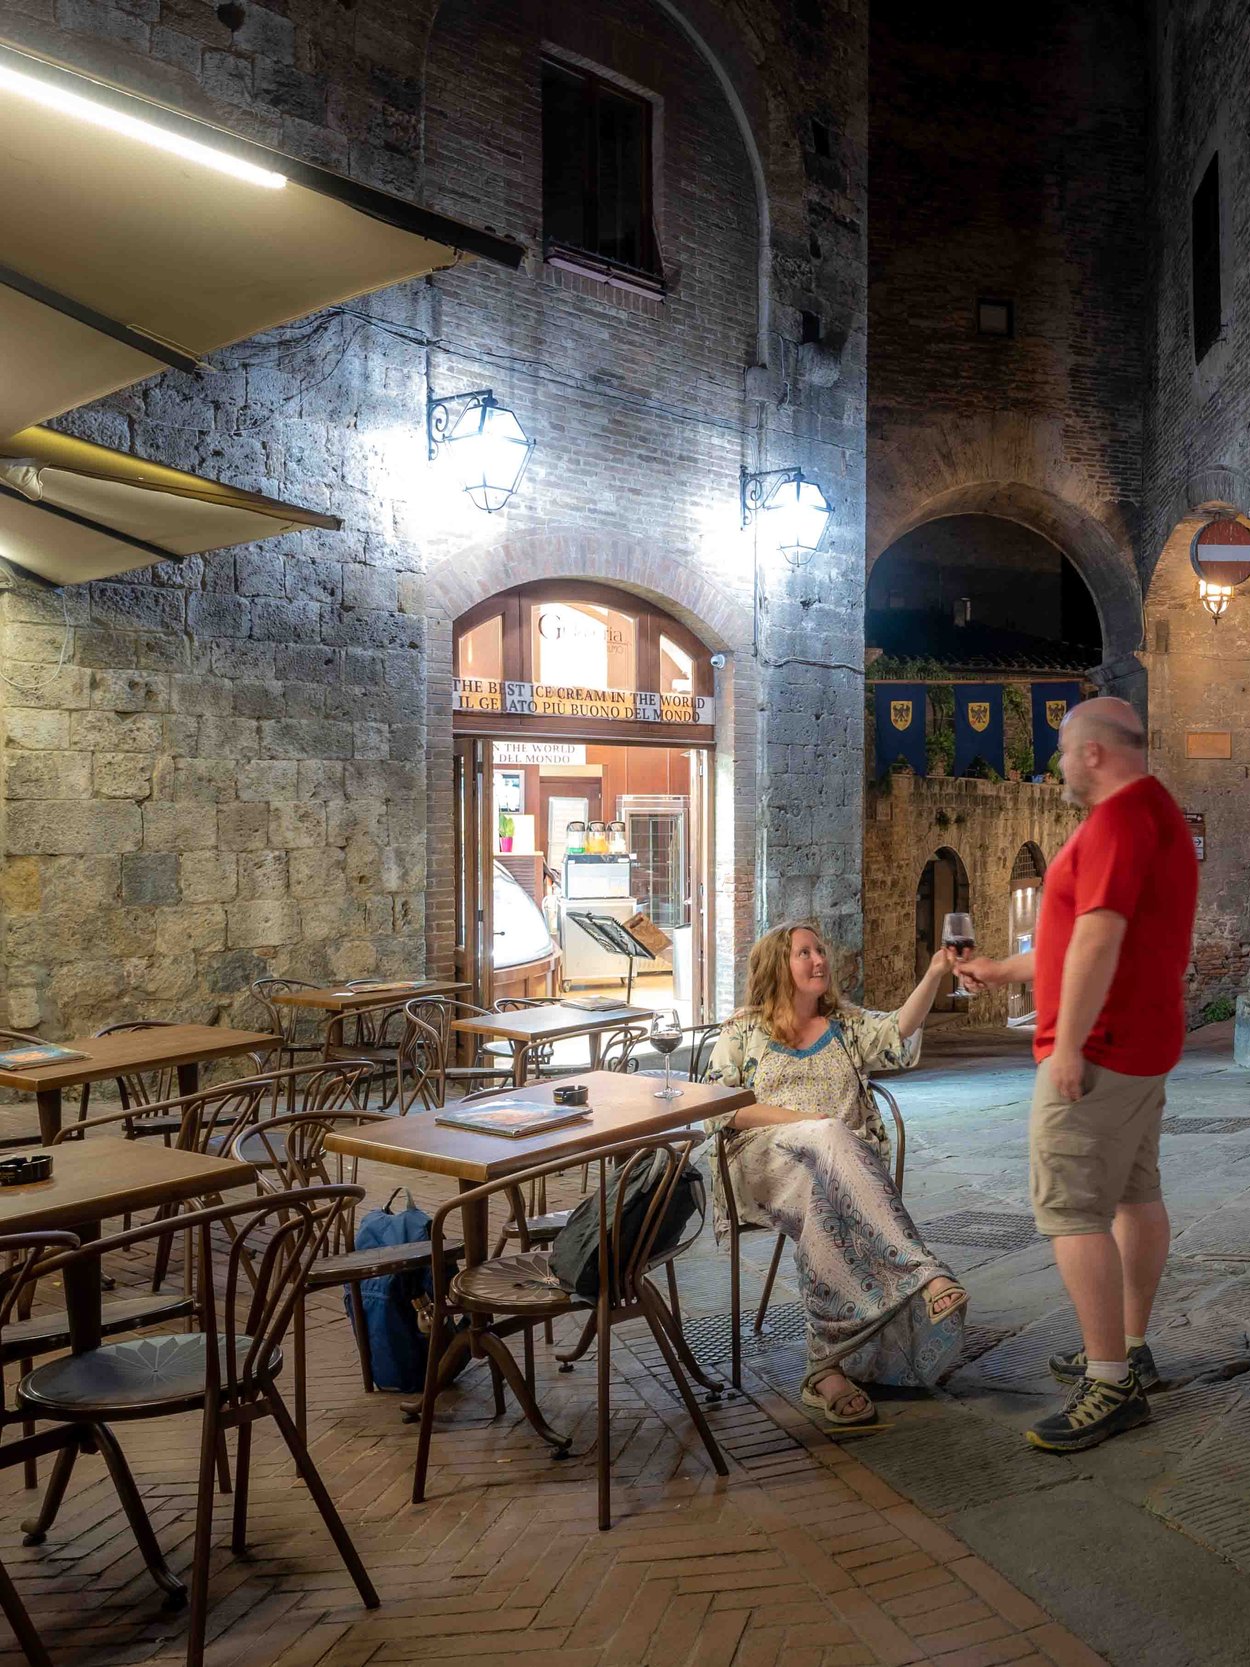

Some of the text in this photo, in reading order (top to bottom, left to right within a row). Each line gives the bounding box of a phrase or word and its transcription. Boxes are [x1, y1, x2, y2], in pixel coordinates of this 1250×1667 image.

[453, 679, 705, 709] THE BEST ICE CREAM IN THE WORLD
[459, 695, 474, 709] IL
[543, 700, 566, 715] PIÙ
[571, 703, 620, 718] BUONO
[625, 707, 649, 720] DEL
[653, 709, 700, 723] MONDO
[504, 743, 527, 753] THE
[532, 744, 575, 753] WORLD
[499, 753, 570, 764] DEL MONDO
